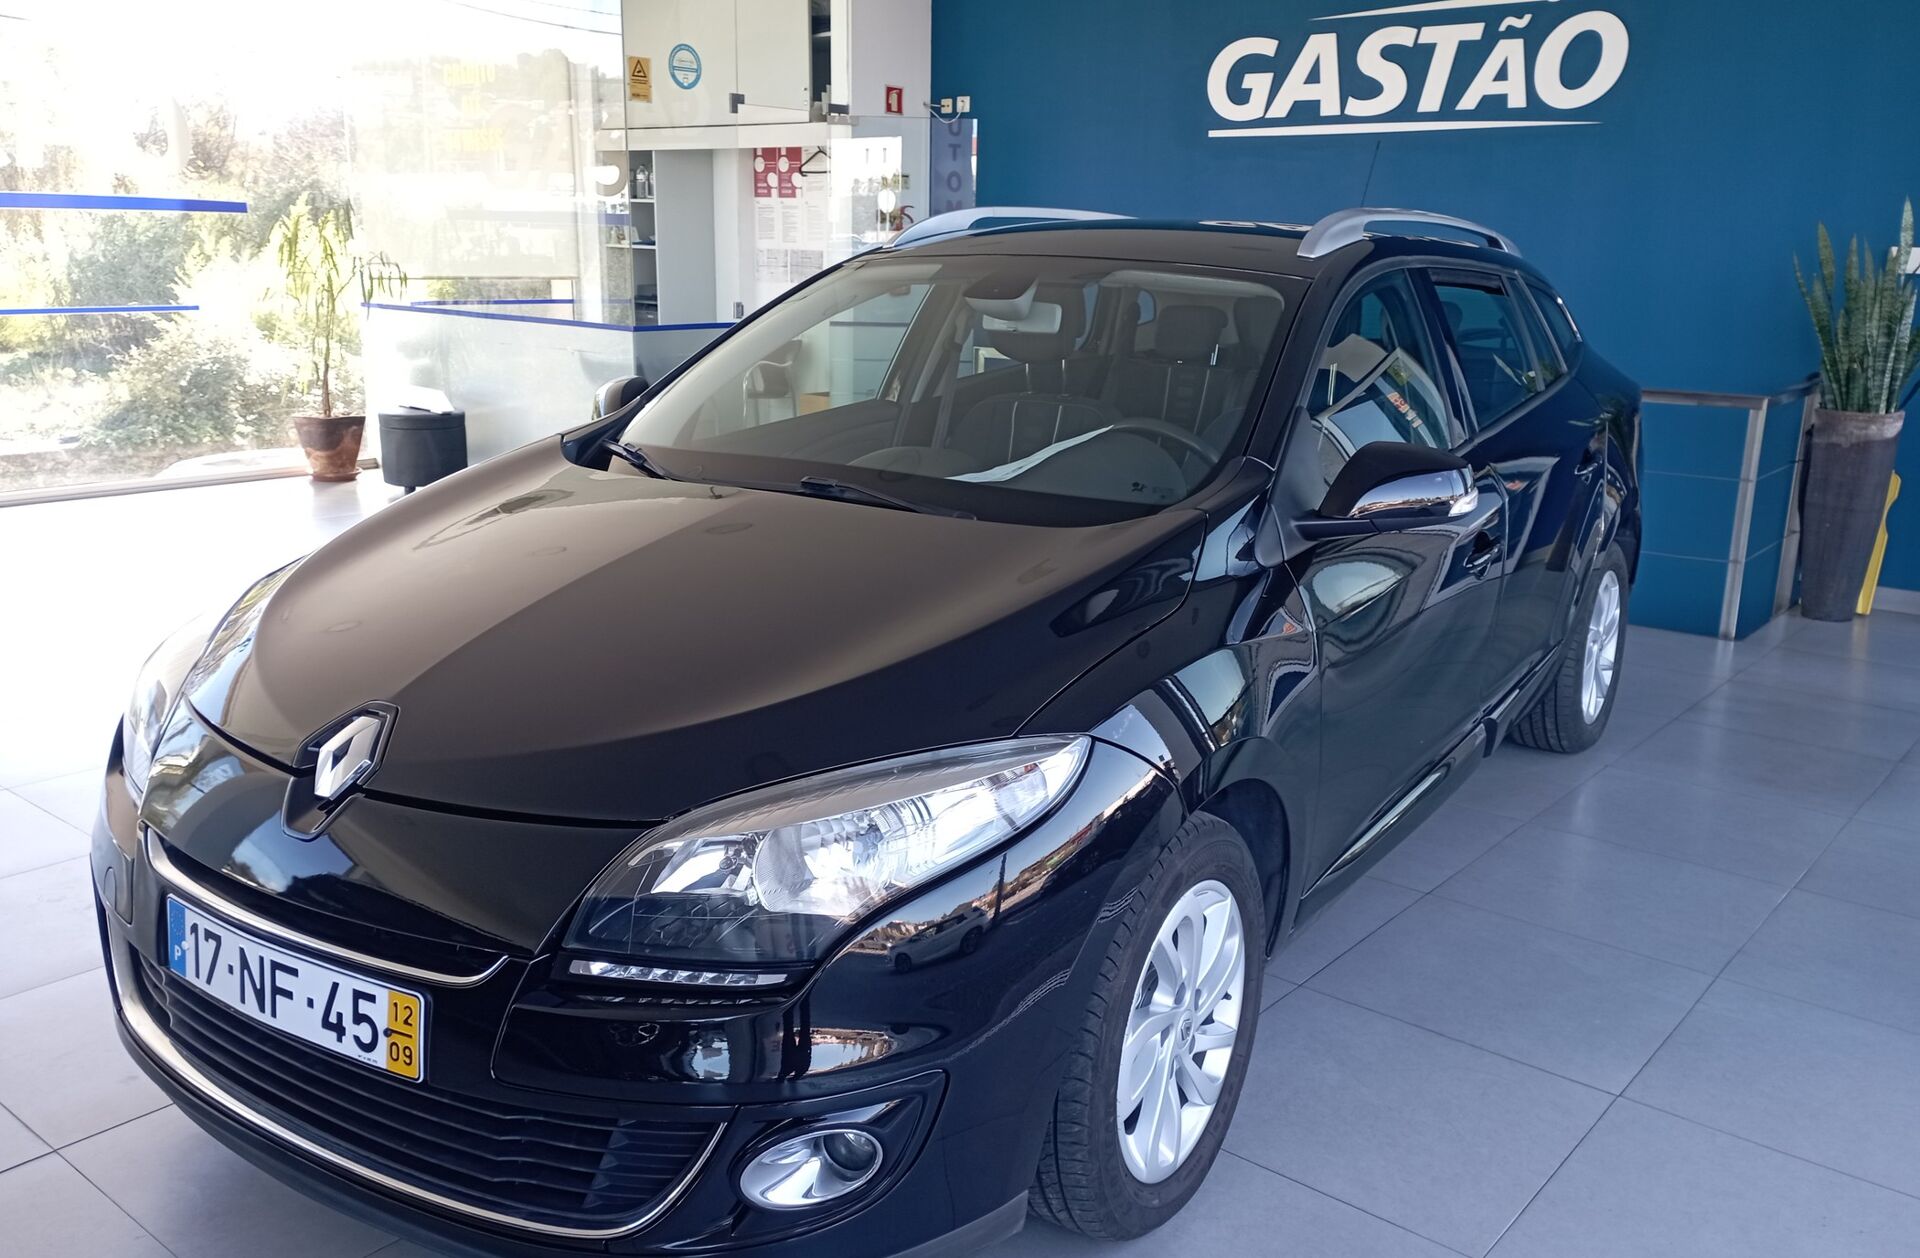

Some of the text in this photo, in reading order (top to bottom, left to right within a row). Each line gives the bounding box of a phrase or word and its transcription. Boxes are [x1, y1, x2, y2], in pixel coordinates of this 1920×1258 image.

[1207, 10, 1629, 121] GASTÃO
[174, 944, 182, 961] P
[393, 1002, 413, 1027] 12
[389, 1041, 413, 1066] 09
